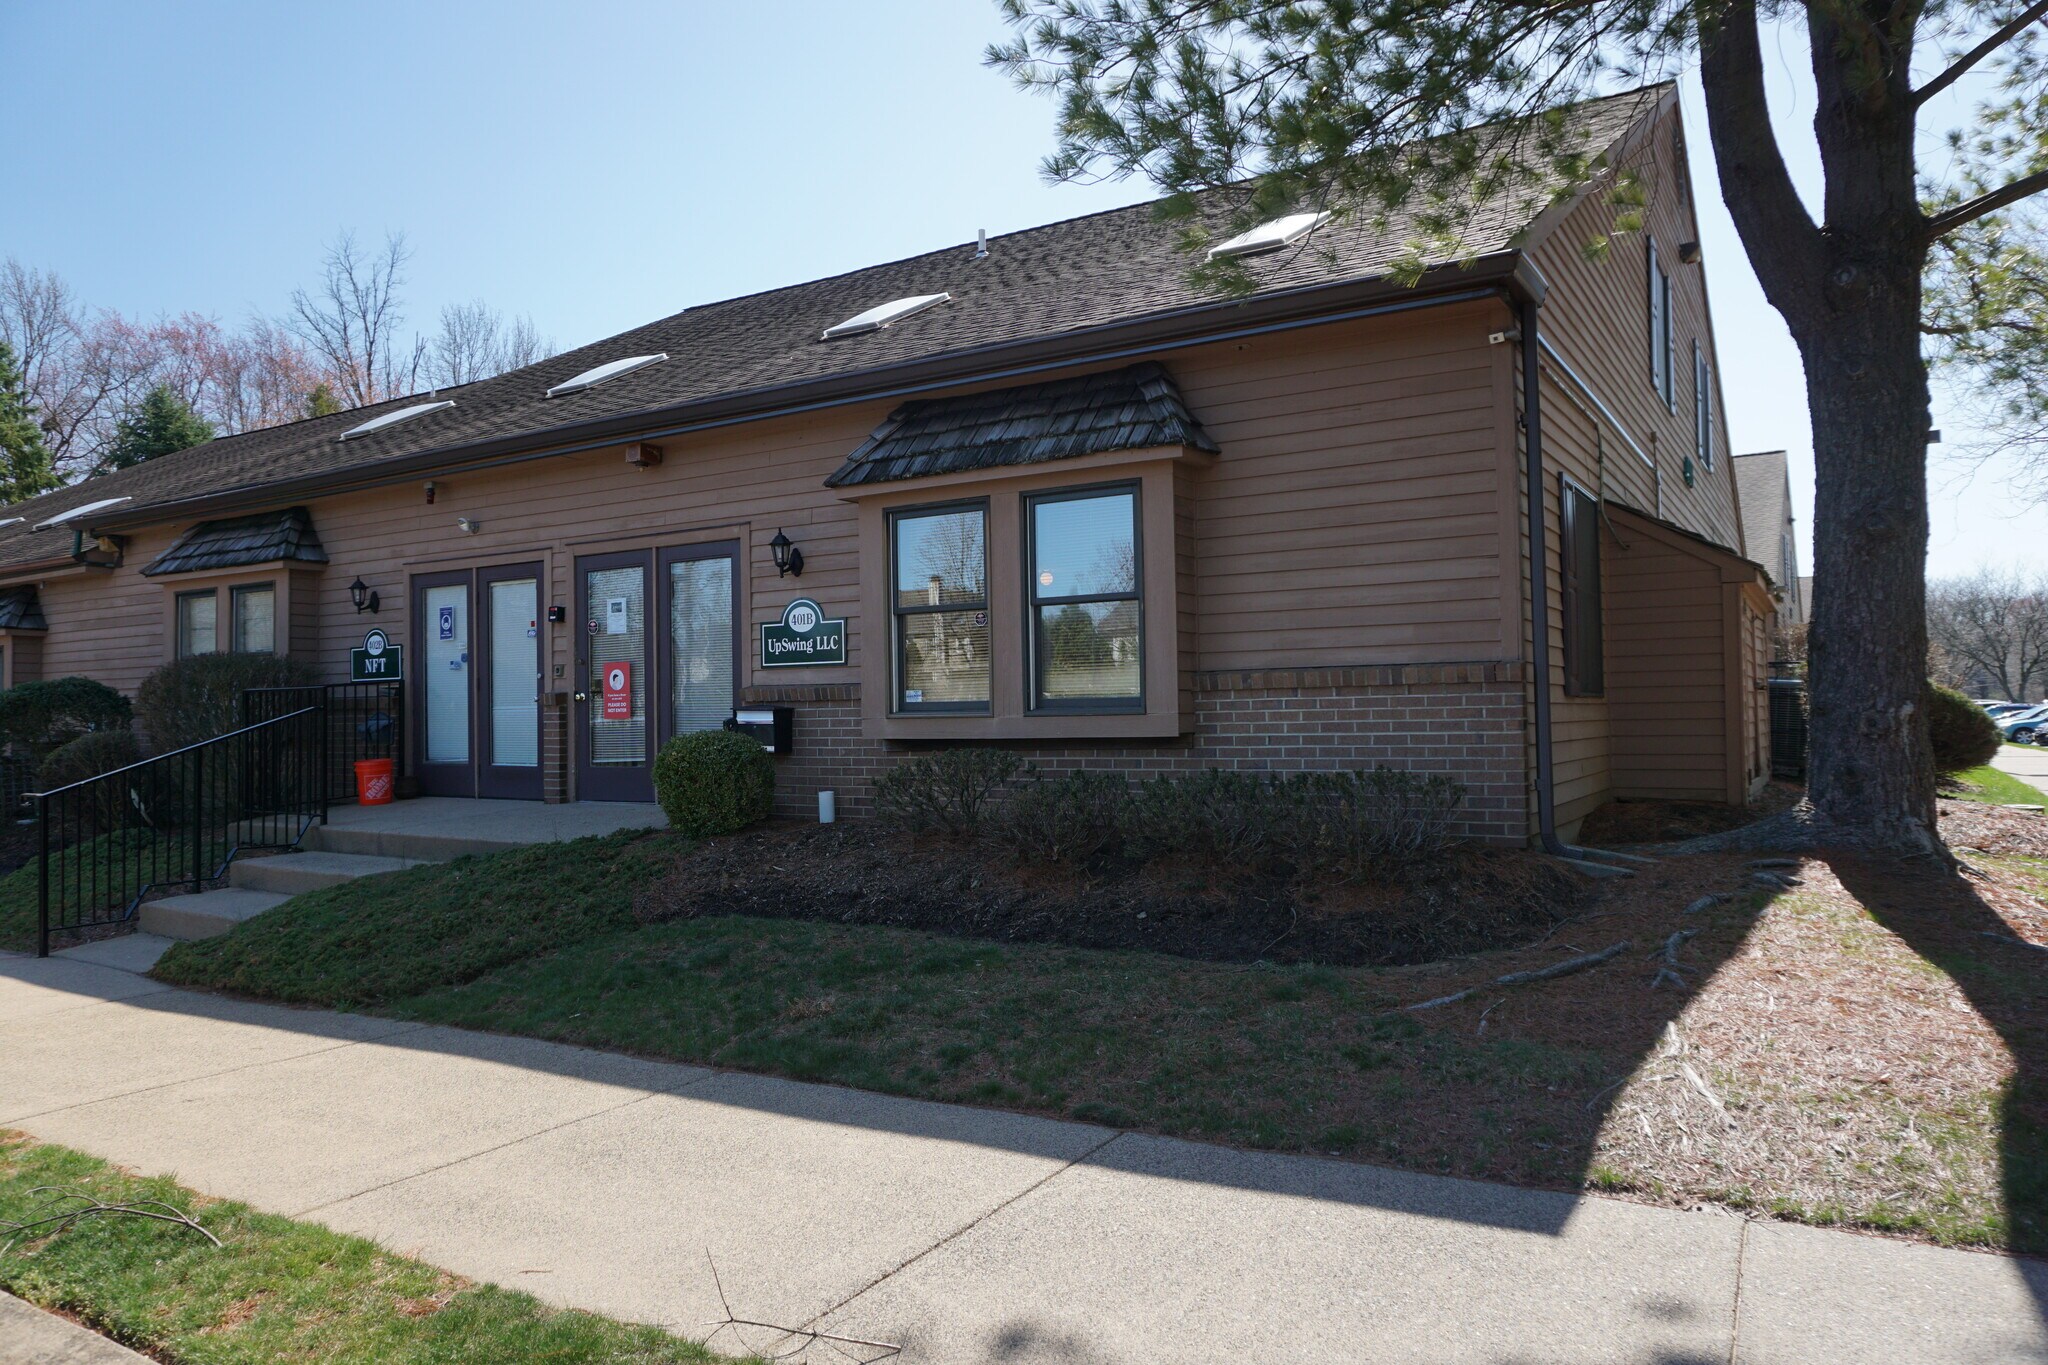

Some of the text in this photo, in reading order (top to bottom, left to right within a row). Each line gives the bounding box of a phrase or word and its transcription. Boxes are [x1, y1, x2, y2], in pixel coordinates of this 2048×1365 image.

[791, 613, 813, 625] 401B
[369, 640, 382, 650] 402B
[768, 635, 838, 654] UpSwing LLC
[365, 658, 386, 673] NFT
